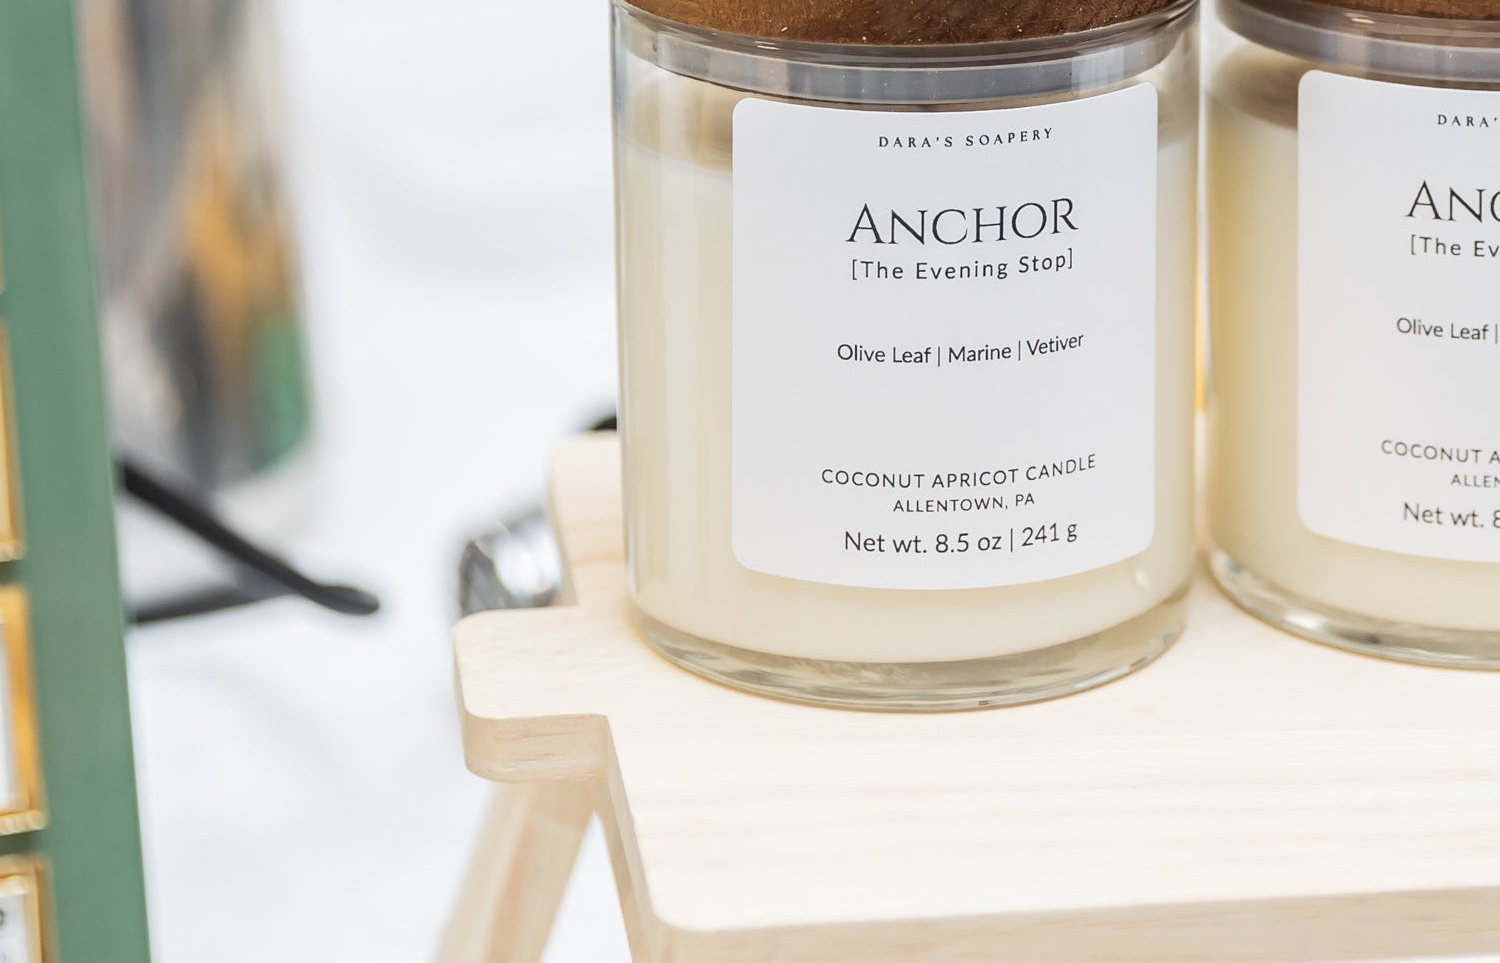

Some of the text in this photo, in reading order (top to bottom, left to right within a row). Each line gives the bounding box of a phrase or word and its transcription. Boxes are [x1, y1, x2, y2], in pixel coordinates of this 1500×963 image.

[878, 127, 1052, 148] DARA'S SOAPERY
[845, 197, 1079, 246] ANCHOR
[1410, 233, 1462, 257] [The
[852, 247, 1073, 281] [The Evening Stop]
[1396, 317, 1444, 338] Olive
[1450, 322, 1489, 341] Leaf
[837, 343, 886, 363] Olive
[892, 346, 932, 364] Leaf
[948, 344, 1012, 364] Marine
[1025, 334, 1085, 356] Vetiver
[1380, 439, 1483, 464] COCONUT
[821, 453, 1096, 489] COCONUT APRICOT CANDLE
[892, 492, 1035, 513] ALLENTOWN, PA
[1403, 501, 1443, 526] Net
[1450, 510, 1484, 529] wt.
[844, 530, 886, 553] Net
[892, 535, 928, 554] wt.
[935, 532, 970, 554] 8.5
[977, 535, 1002, 552] oz
[1021, 522, 1061, 547] 241
[1066, 523, 1078, 543] g
